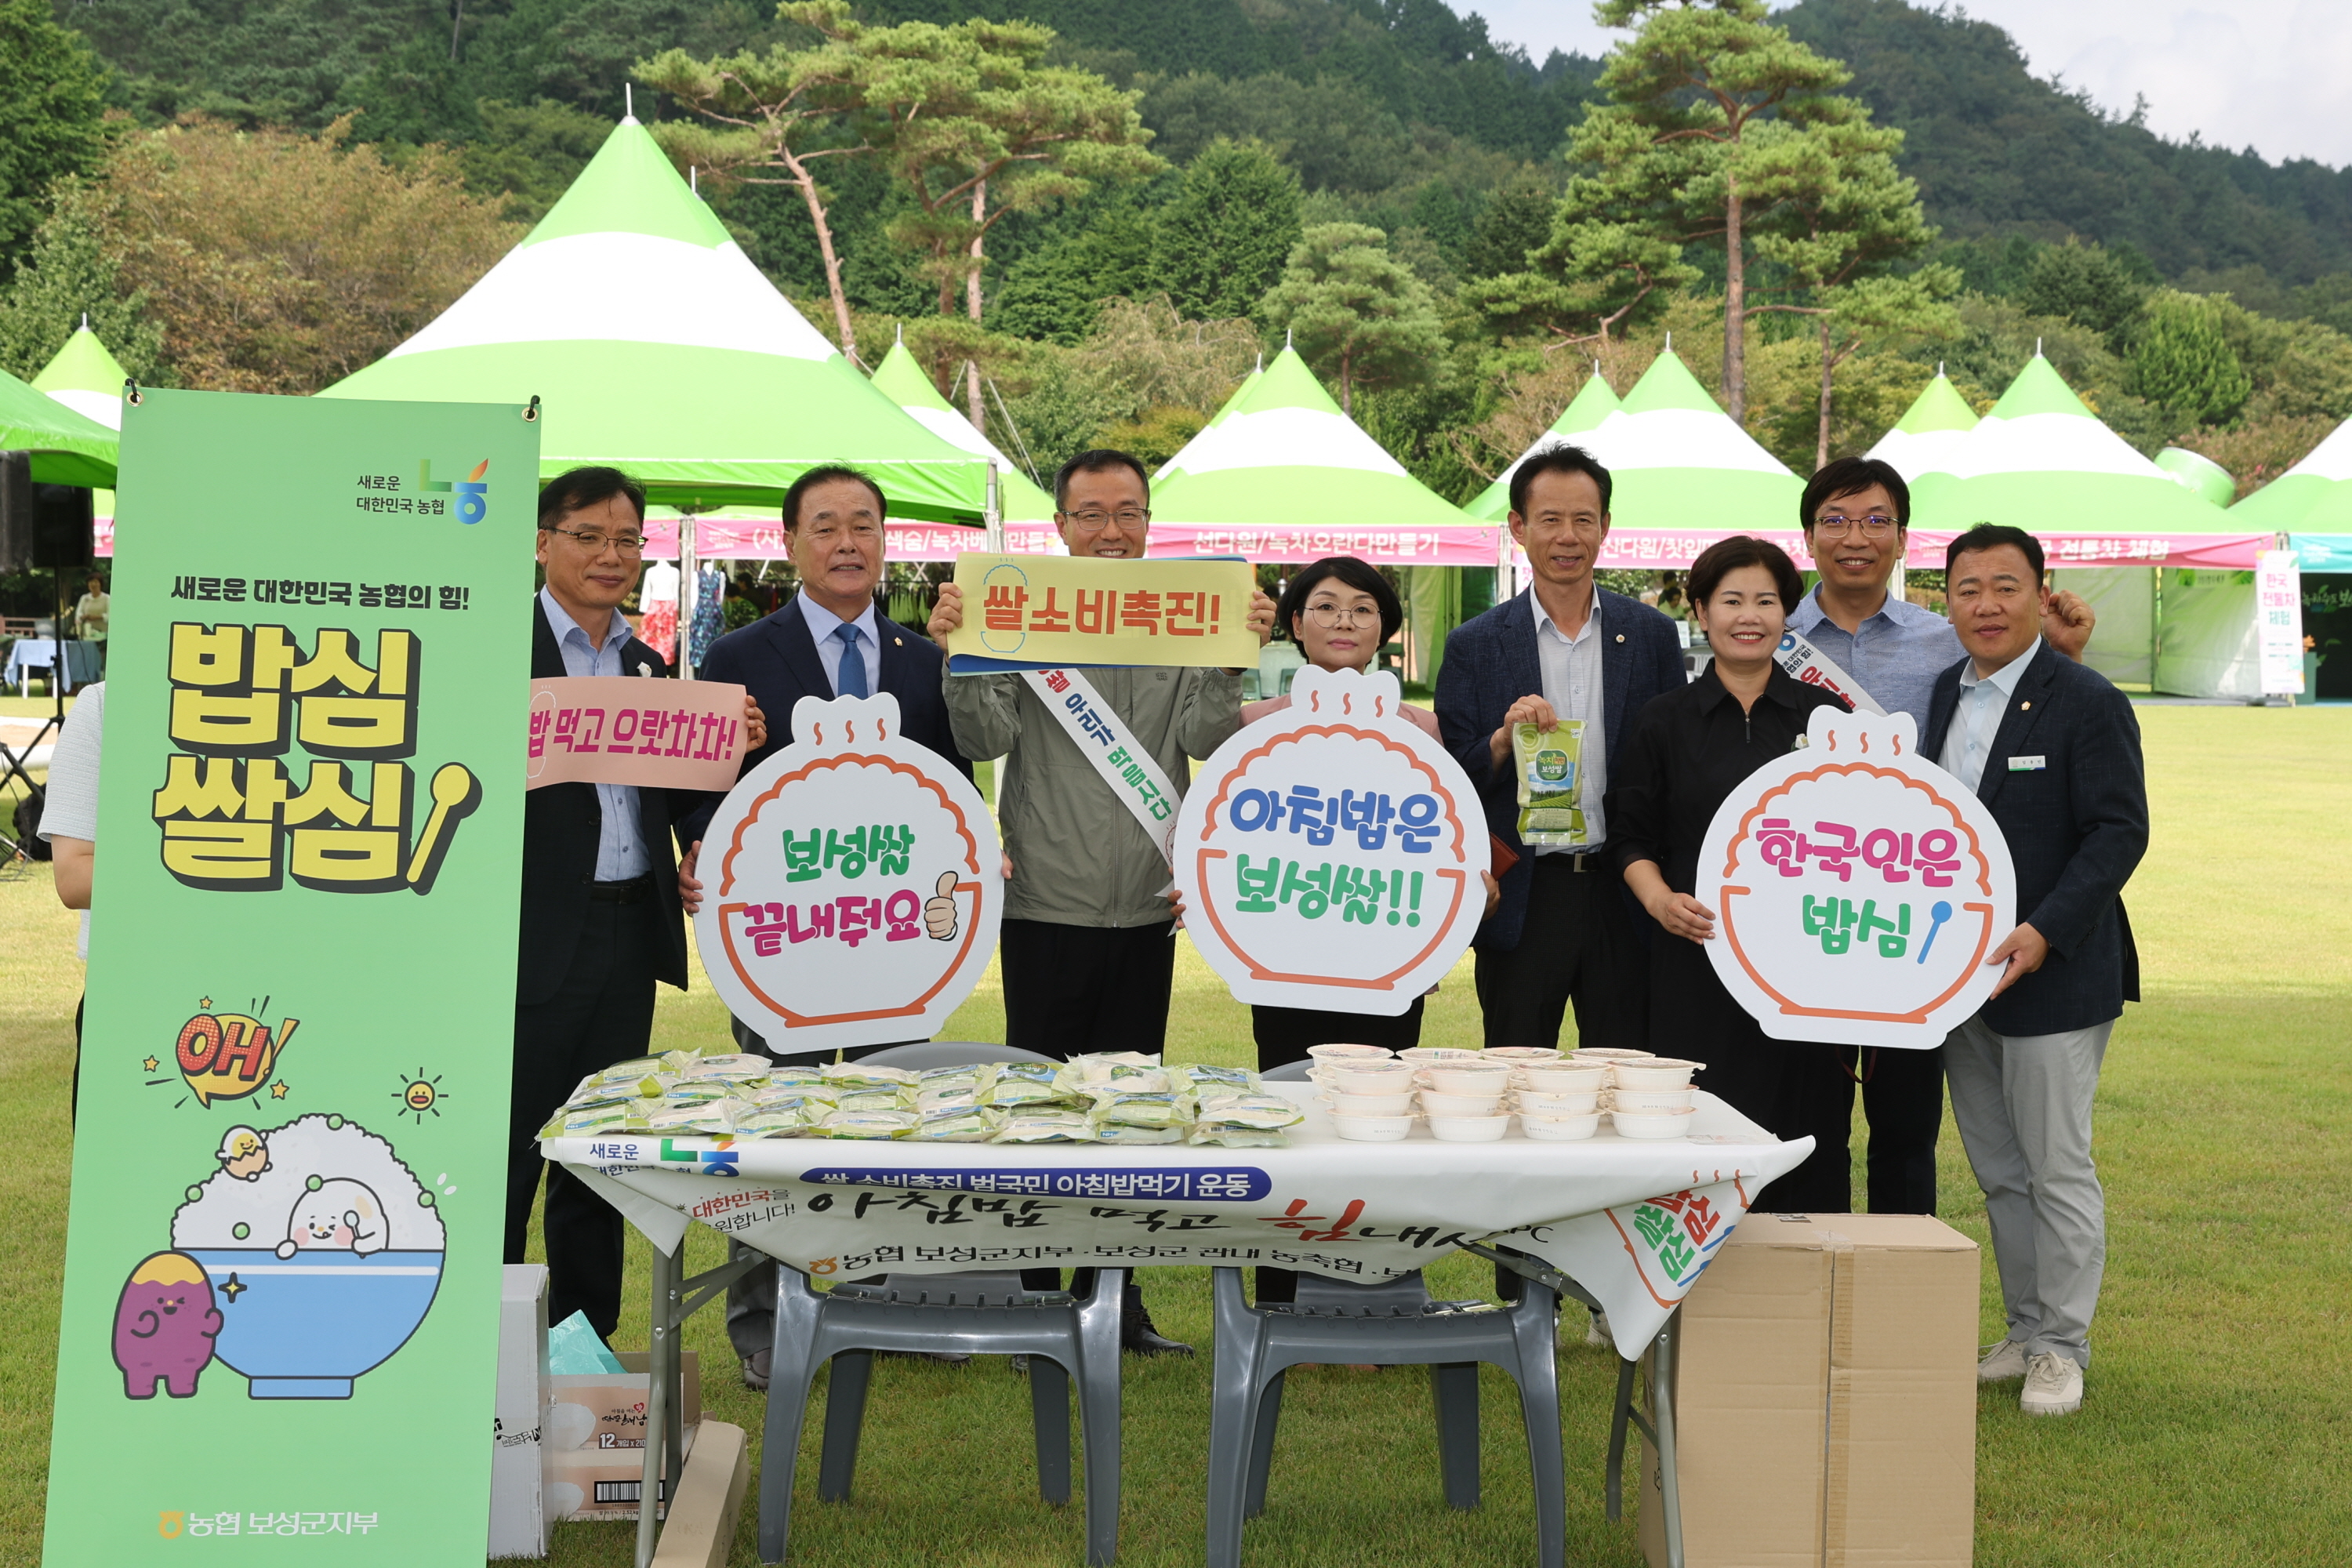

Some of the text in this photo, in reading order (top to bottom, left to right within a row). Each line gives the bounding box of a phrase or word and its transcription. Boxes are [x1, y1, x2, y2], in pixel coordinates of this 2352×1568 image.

[356, 474, 401, 492] 새로운
[356, 496, 445, 516] 대한민국 농협
[170, 575, 470, 611] 새로운 대한민국 농협의 힘!
[983, 585, 1221, 637] 쌀소비촉진!
[1785, 648, 1814, 673] 협의 힘!
[1788, 644, 1806, 662] 대한민국
[169, 622, 419, 759] 밥심
[528, 708, 738, 761] 밥 먹고 으랏차차!
[1065, 693, 1116, 746] 우리가
[1106, 746, 1172, 822] 먹읍시다
[1541, 765, 1563, 774] 보성쌀
[1229, 785, 1441, 854] 아침밥은
[782, 824, 915, 883] 보성쌀
[1756, 818, 1962, 887] 한국인은
[1236, 854, 1424, 928] 보성쌀!!
[743, 889, 921, 956] 끝내줘요
[1802, 894, 1911, 958] 밥심
[176, 1014, 299, 1080] OH!
[590, 1143, 640, 1160] 새로운
[692, 1188, 791, 1218] 대한민국을
[855, 1173, 962, 1190] 소비촉진
[970, 1173, 1050, 1194] 범국민
[1056, 1173, 1189, 1197] 아침밥먹기
[1196, 1173, 1251, 1198] 운동
[808, 1191, 1063, 1228] 아침밥
[1090, 1205, 1232, 1232] 먹고
[843, 1245, 904, 1271] 농협
[914, 1245, 1074, 1263] 보성군지부
[1094, 1245, 1189, 1259] 보성군
[1199, 1246, 1261, 1259] 관내
[1271, 1248, 1363, 1276] 농축협
[600, 1432, 615, 1448] 12
[187, 1511, 379, 1537] 농협 보성군지부
